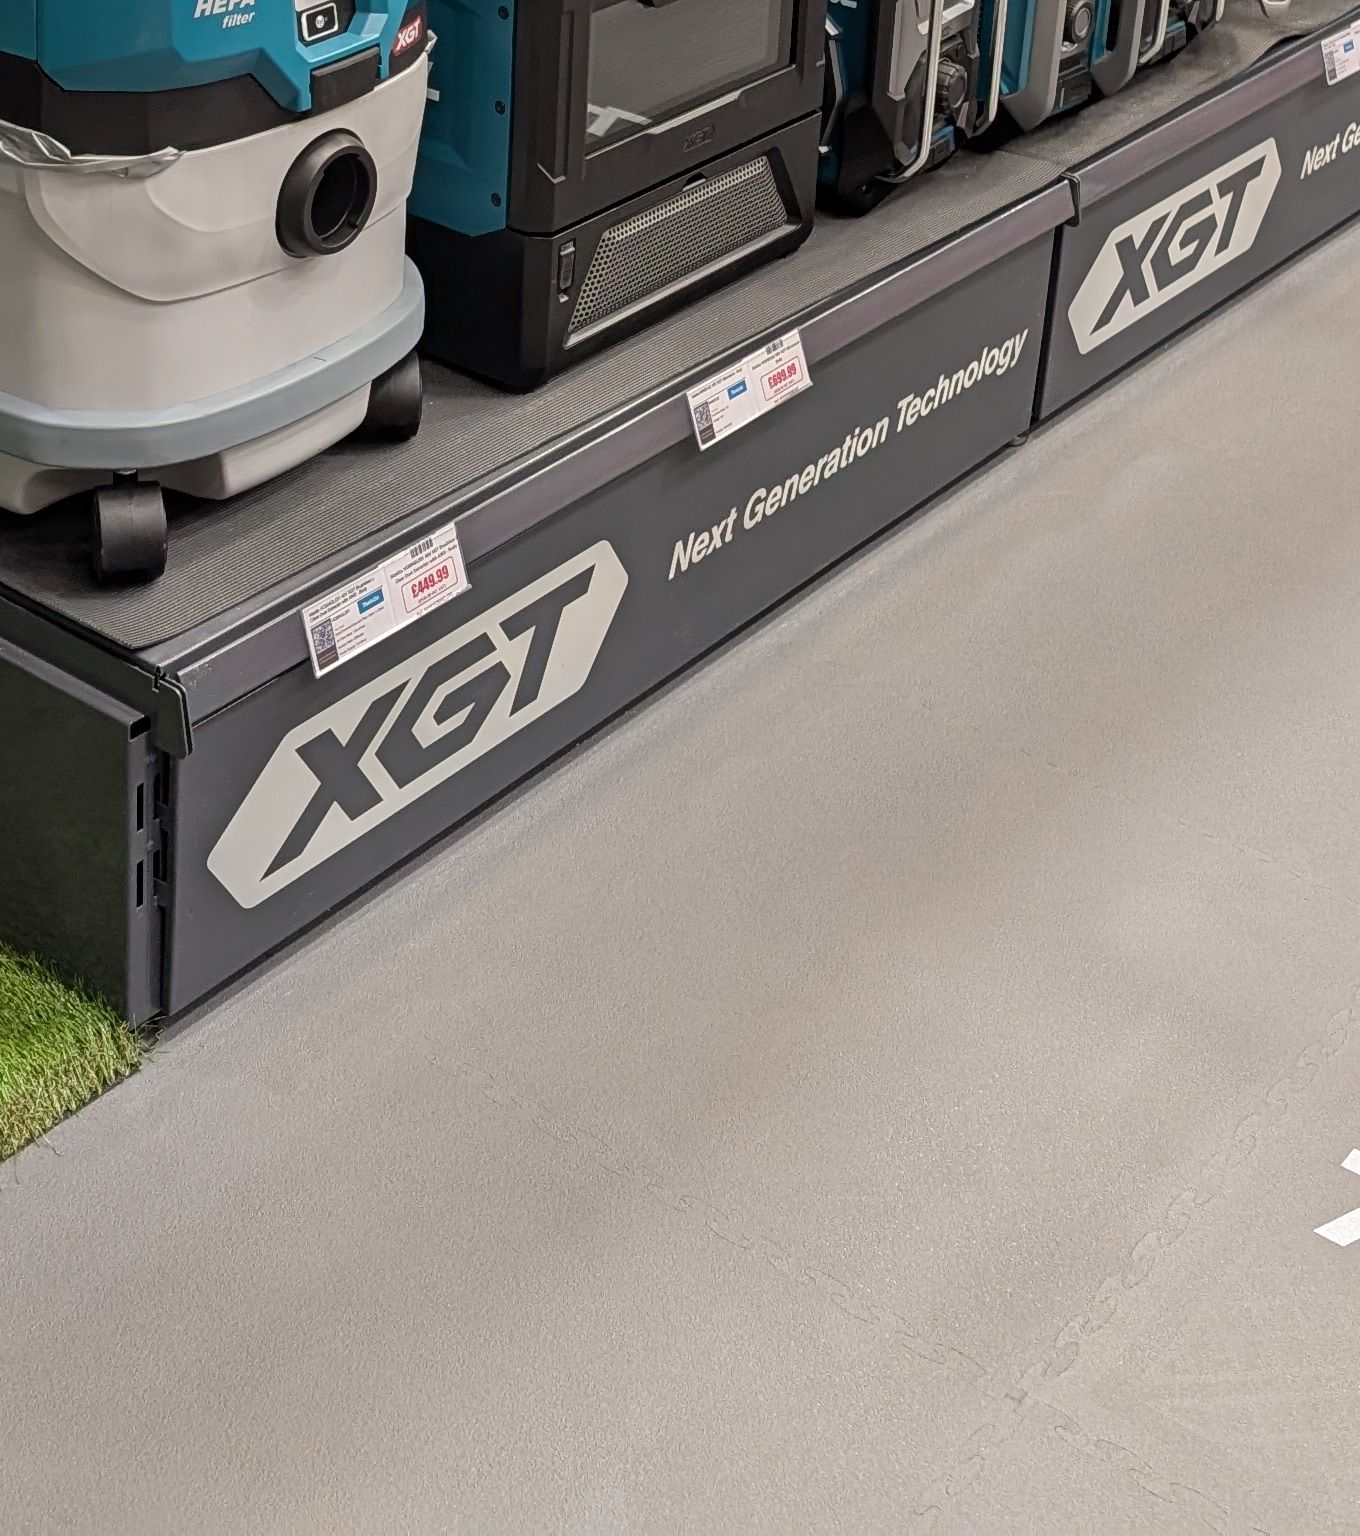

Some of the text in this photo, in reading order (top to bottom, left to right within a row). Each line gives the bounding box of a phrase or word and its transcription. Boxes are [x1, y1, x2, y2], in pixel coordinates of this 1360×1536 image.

[221, 10, 257, 30] filter
[396, 15, 422, 51] XGT
[1088, 165, 1263, 337] XGT
[1300, 133, 1340, 180] Next
[767, 362, 797, 390] £699.99
[410, 564, 450, 600] £449.99
[260, 561, 600, 883] XGT
[668, 518, 737, 581] Next
[745, 416, 889, 532] Generation
[897, 326, 1030, 435] Technology
